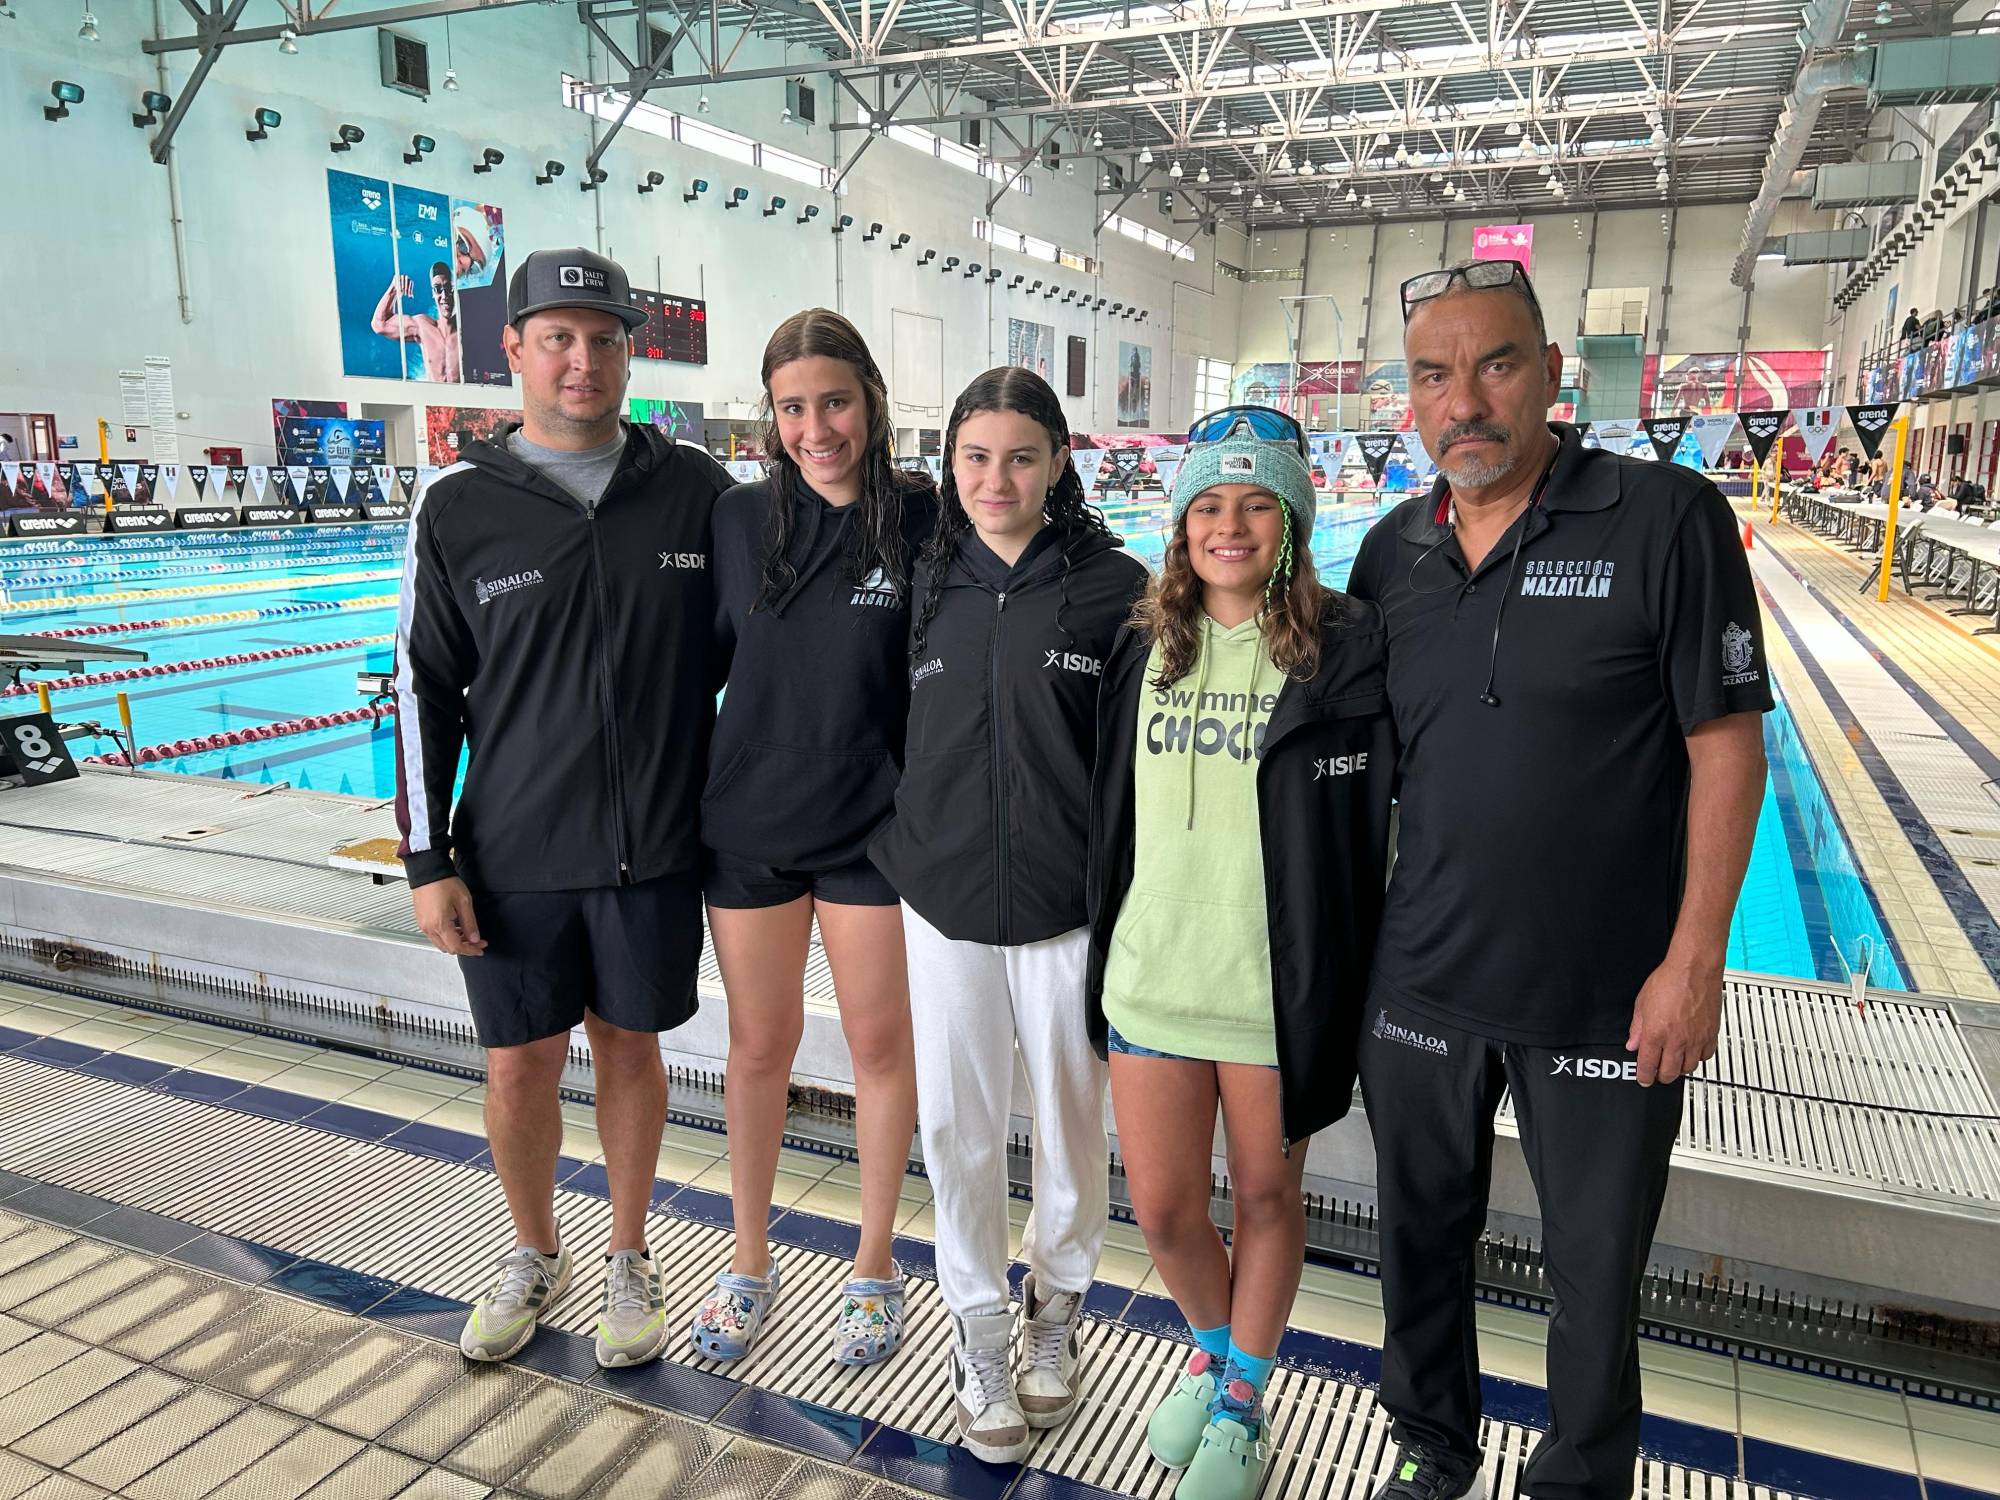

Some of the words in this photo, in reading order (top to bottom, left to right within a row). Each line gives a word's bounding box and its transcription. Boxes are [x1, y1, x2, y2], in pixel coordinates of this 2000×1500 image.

[362, 189, 381, 200] arena
[434, 235, 448, 248] ciel
[584, 270, 604, 280] SALTY
[585, 278, 604, 288] CREW
[1857, 409, 1888, 419] arena
[1749, 415, 1778, 426] arena
[1653, 422, 1681, 432] arena
[1365, 439, 1389, 448] arena
[1117, 453, 1138, 461] arena
[249, 510, 278, 520] arena
[314, 507, 341, 518] arena
[369, 505, 394, 517] arena
[20, 518, 57, 530] arena
[115, 515, 149, 527] arena
[184, 512, 215, 524] arena
[1526, 560, 1615, 576] SELECCIÓN
[487, 569, 543, 593] SINALOA
[1521, 576, 1612, 597] MAZATLÁN
[1063, 652, 1102, 677] ISDE
[14, 724, 52, 758] 8
[1329, 752, 1368, 776] ISDE
[1384, 1022, 1448, 1052] SINALOA
[1576, 1058, 1637, 1080] ISDE
